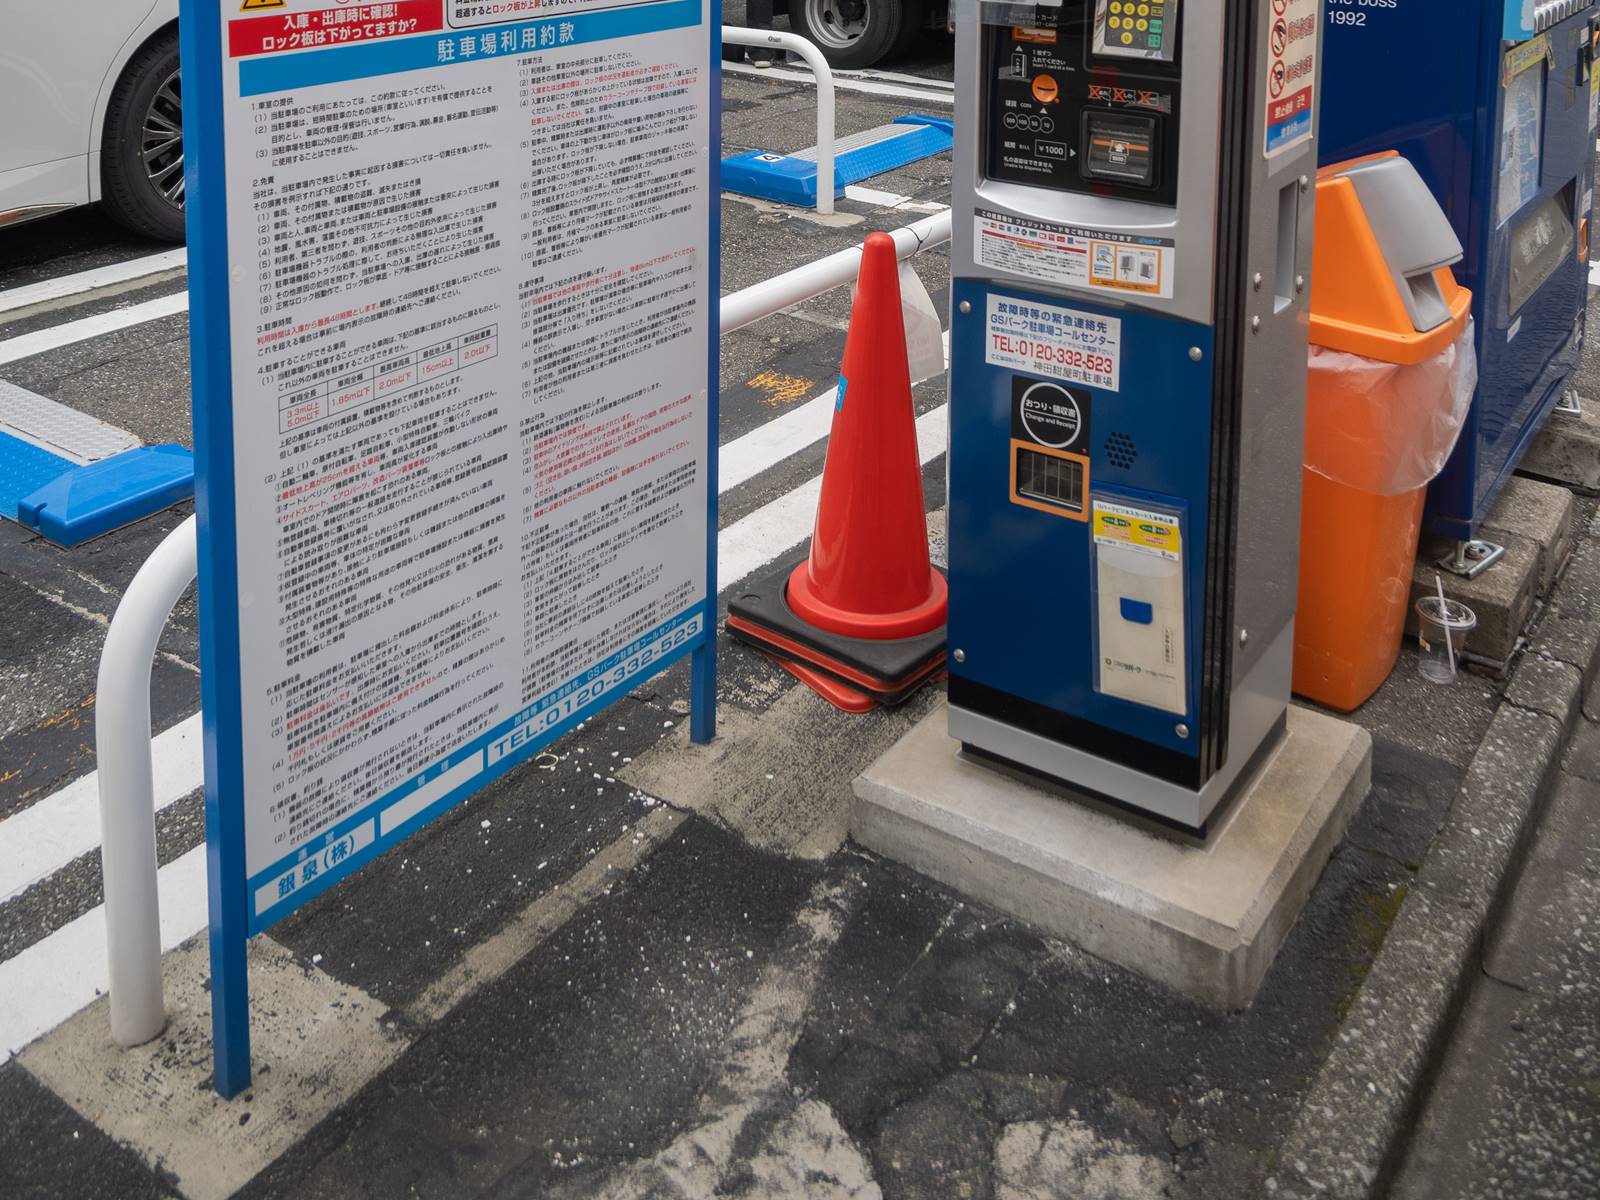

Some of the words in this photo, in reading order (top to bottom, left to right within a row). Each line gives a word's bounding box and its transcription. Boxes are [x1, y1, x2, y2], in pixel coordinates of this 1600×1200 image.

[261, 17, 417, 51] ロック板は下がってますか?
[283, 2, 398, 31] 入庫・出庫時に確認!
[1328, 10, 1366, 26] 1992
[437, 19, 574, 63] 駐車場利用約款
[992, 334, 1113, 374] TEL:0120-332-523
[494, 620, 699, 758] TEL:0120-332-523
